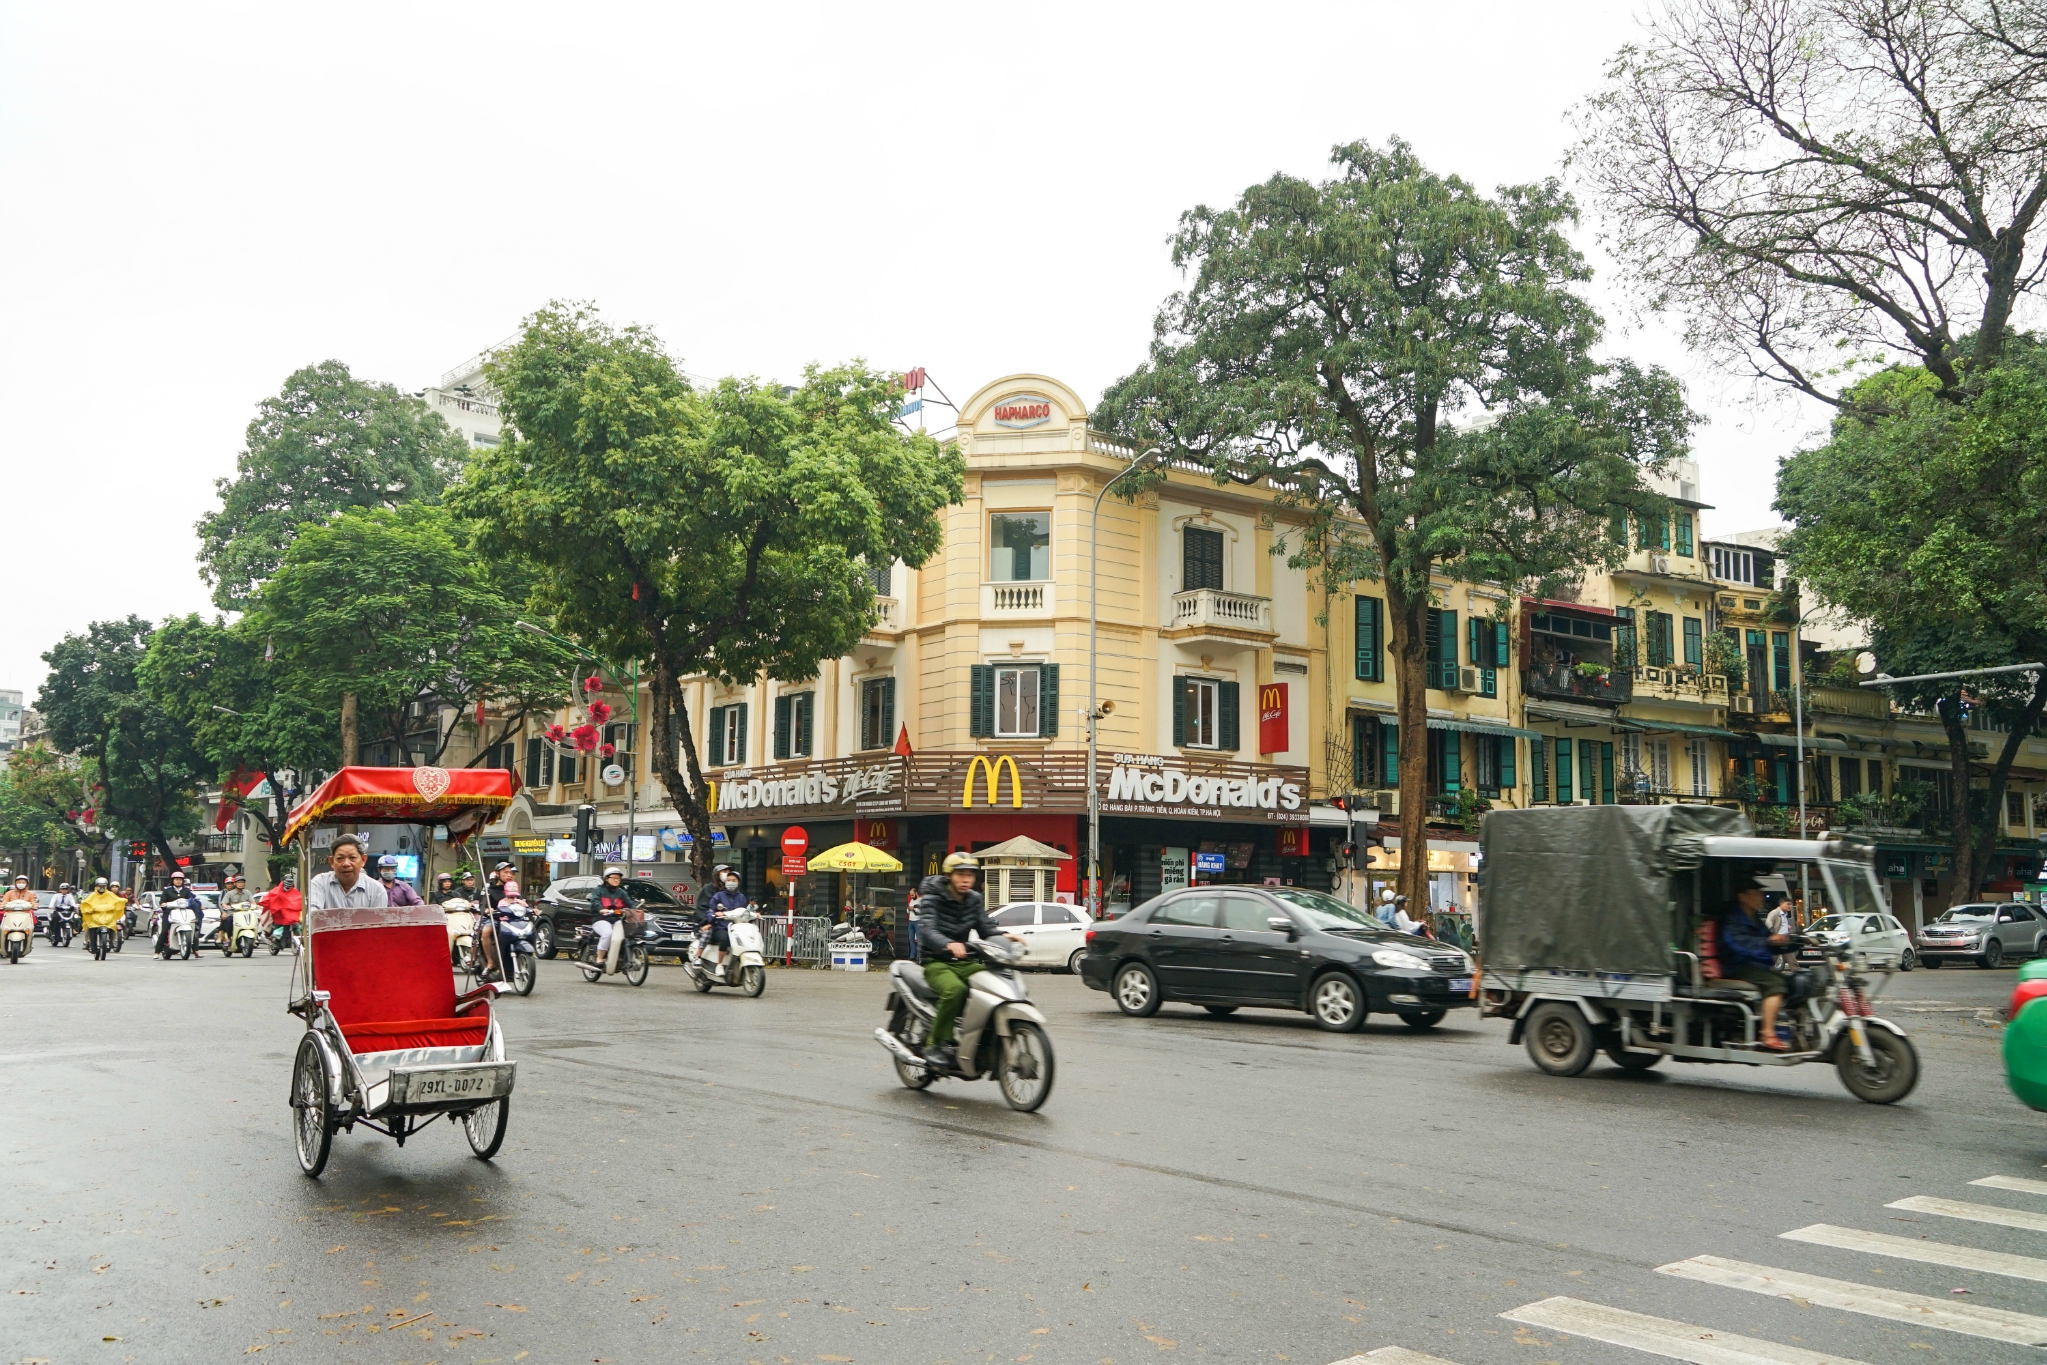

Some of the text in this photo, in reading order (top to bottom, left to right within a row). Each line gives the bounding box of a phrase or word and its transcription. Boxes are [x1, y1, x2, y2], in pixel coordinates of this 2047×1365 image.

[994, 404, 1050, 420] HAPHARCO
[1136, 753, 1164, 767] HÀNG
[718, 773, 838, 812] McDonald's
[1108, 767, 1300, 810] McDonald's
[1109, 803, 1123, 812] HÀNG
[1197, 861, 1210, 869] HÀNG
[1164, 874, 1173, 885] gà
